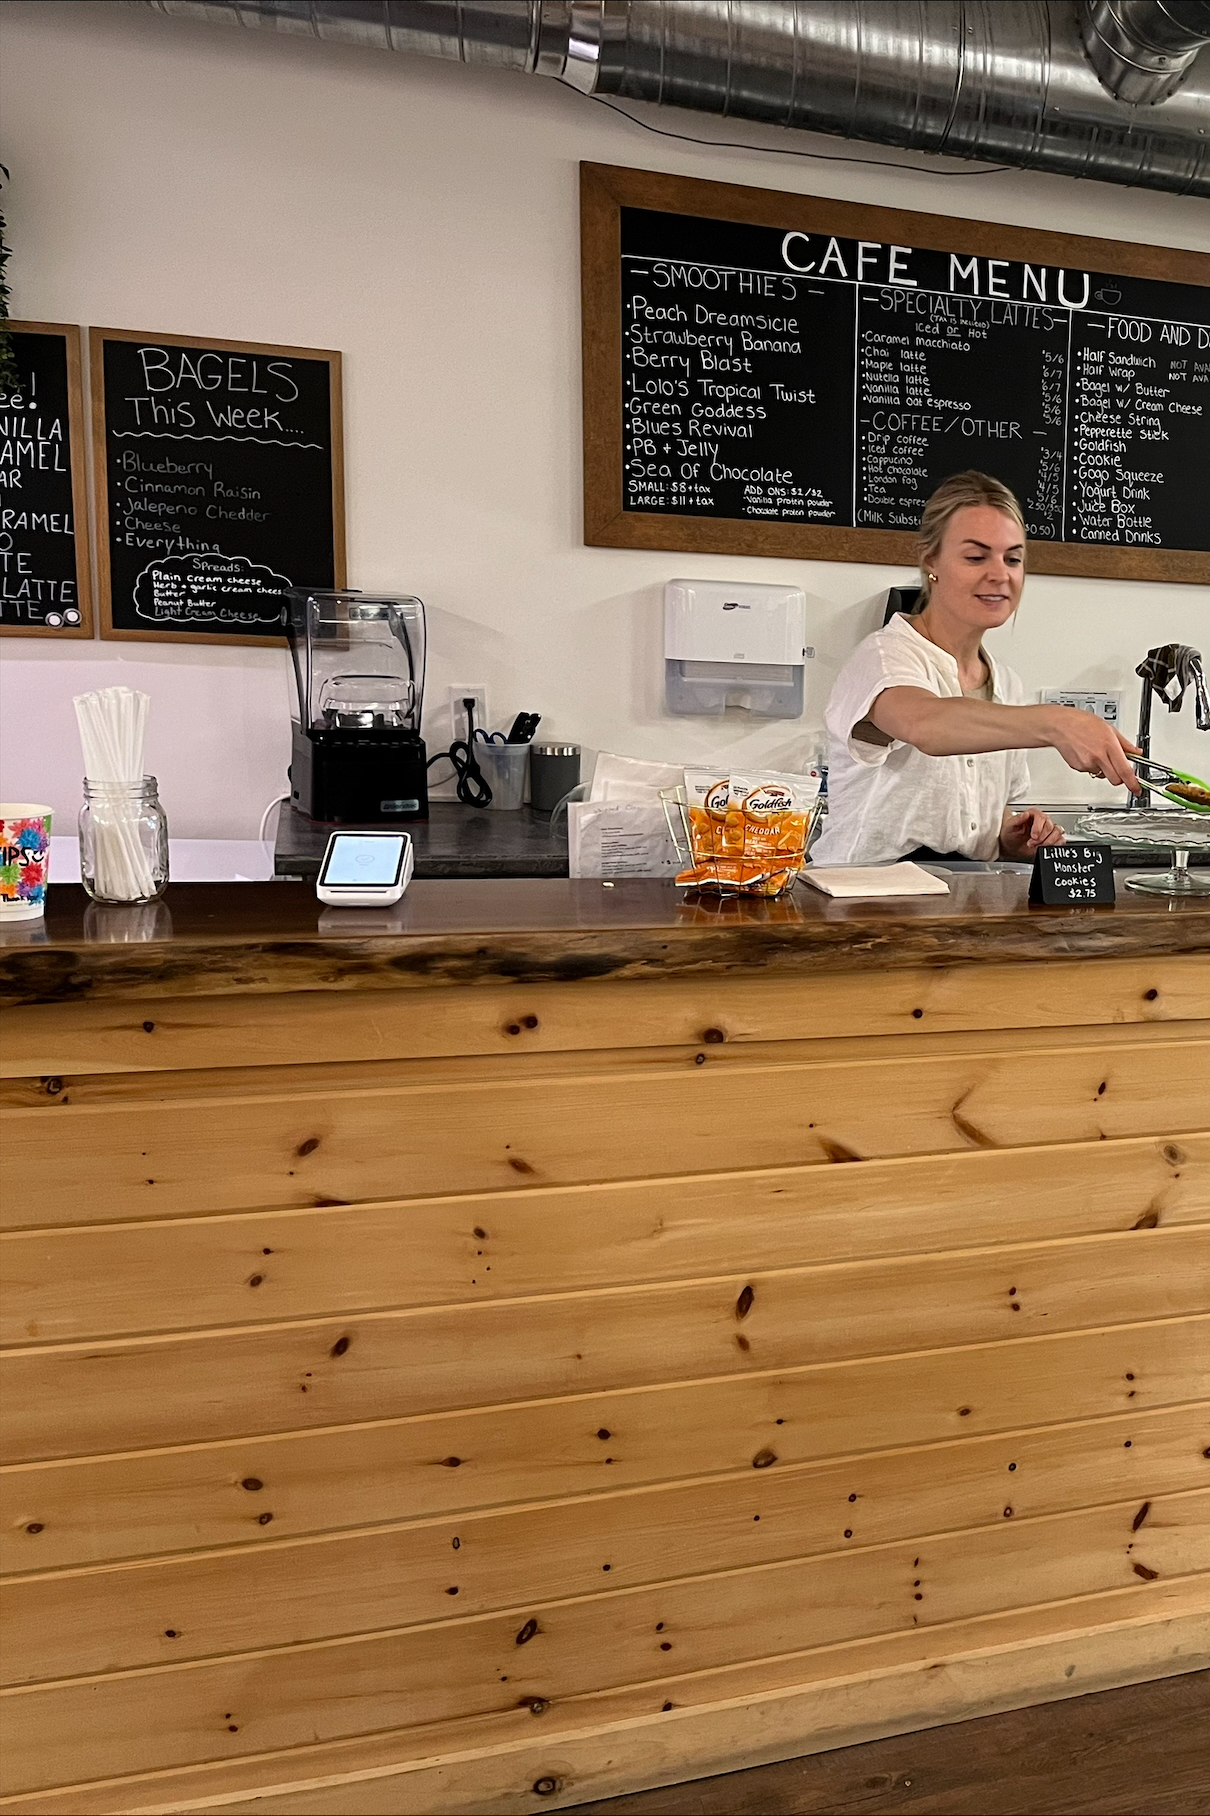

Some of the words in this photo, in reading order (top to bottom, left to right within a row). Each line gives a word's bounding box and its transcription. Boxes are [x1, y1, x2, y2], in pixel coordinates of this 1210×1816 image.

[781, 231, 917, 287] CAFE
[949, 253, 1090, 310] MENU
[653, 263, 797, 300] SMOOTHIES
[632, 295, 687, 322] Peach
[695, 304, 800, 334] Dreamsicle
[880, 288, 982, 321] SPECIALTY
[991, 301, 1054, 331] LATTES
[1108, 317, 1152, 343] FOOD
[1160, 324, 1190, 346] AND
[630, 324, 733, 356] Strawberry
[741, 331, 802, 354] Banana
[865, 331, 909, 345] Caramel
[916, 336, 970, 352] macchiato
[865, 346, 889, 357] Chai
[901, 349, 927, 361] latte
[1083, 347, 1105, 362] Half
[1109, 352, 1156, 368] Sandwich
[632, 347, 689, 378] Berry
[700, 350, 752, 374] Blast
[865, 359, 893, 371] Maple
[900, 362, 927, 375] latte
[1170, 360, 1188, 370] NOT
[137, 348, 298, 402] BAGELS
[866, 372, 899, 383] Nutella
[906, 375, 930, 386] latte
[1083, 362, 1104, 376] Half
[1109, 365, 1135, 381] Wrap
[1169, 373, 1187, 381] NOT
[697, 379, 761, 403] Tropical
[769, 383, 816, 403] Twist
[866, 385, 899, 394] Vanilla
[906, 387, 932, 397] latte
[1080, 378, 1110, 397] Bagel
[1135, 383, 1170, 398] Butter
[629, 397, 681, 415] Green
[691, 403, 767, 419] Goddess
[866, 396, 900, 405] Vanilla
[927, 399, 971, 411] espresso
[1080, 395, 1110, 415] Bagel
[1135, 399, 1164, 411] Cream
[1169, 402, 1203, 415] Cheese
[124, 397, 196, 428] This
[632, 418, 682, 435] Blues
[689, 420, 753, 438] Revival
[1080, 411, 1121, 425] Cheese
[1128, 413, 1161, 432] String
[868, 432, 890, 445] Drip
[897, 435, 929, 446] coffee
[1079, 424, 1133, 439] Pepperette
[633, 438, 656, 456] PB
[676, 439, 719, 464] Jelly
[868, 445, 885, 454] Iced
[894, 446, 924, 456] coffee
[1079, 438, 1127, 452] Goldfish
[123, 450, 213, 480] Blueberry
[867, 455, 913, 468] Cappucino
[1079, 453, 1122, 467] Cookie
[630, 459, 672, 478] Sea
[710, 462, 794, 484] Chocolate
[868, 464, 883, 474] Hot
[1078, 467, 1109, 487] Gogo
[1115, 469, 1164, 487] Squeeze
[125, 476, 205, 496] Cinnamon
[214, 482, 261, 499] Raisin
[868, 475, 897, 484] London
[744, 485, 763, 495] ADD
[868, 485, 886, 493] Tea
[1079, 481, 1117, 508] Yogurt
[1123, 486, 1150, 500] Drink
[630, 496, 669, 505] LARGE:
[868, 496, 895, 505] Double
[1077, 499, 1106, 513] Juice
[1111, 500, 1135, 513] Box
[123, 497, 197, 516] Jalepeno
[206, 505, 271, 522] Chedder
[125, 517, 181, 533] Cheese
[1079, 515, 1113, 527] Water
[1117, 513, 1152, 529] Bottle
[126, 533, 220, 555] Everything
[1080, 528, 1119, 542] Canned
[1125, 530, 1161, 544] Drinks
[152, 570, 181, 581] Plain
[227, 578, 262, 586] cheese
[3, 577, 75, 602] LATTE
[154, 589, 186, 597] Butter
[190, 584, 217, 593] garlic
[154, 598, 184, 606] Peanut
[187, 599, 216, 607] Butter
[155, 607, 182, 618] Light
[185, 608, 216, 616] Cream
[220, 608, 259, 619] Cheese
[750, 797, 792, 810] Goldfish
[745, 824, 780, 835] CHEDDAR
[0, 846, 32, 866] IPS
[1083, 847, 1103, 864] Big
[1054, 862, 1095, 874] Monster
[1068, 888, 1097, 899] $2.75
